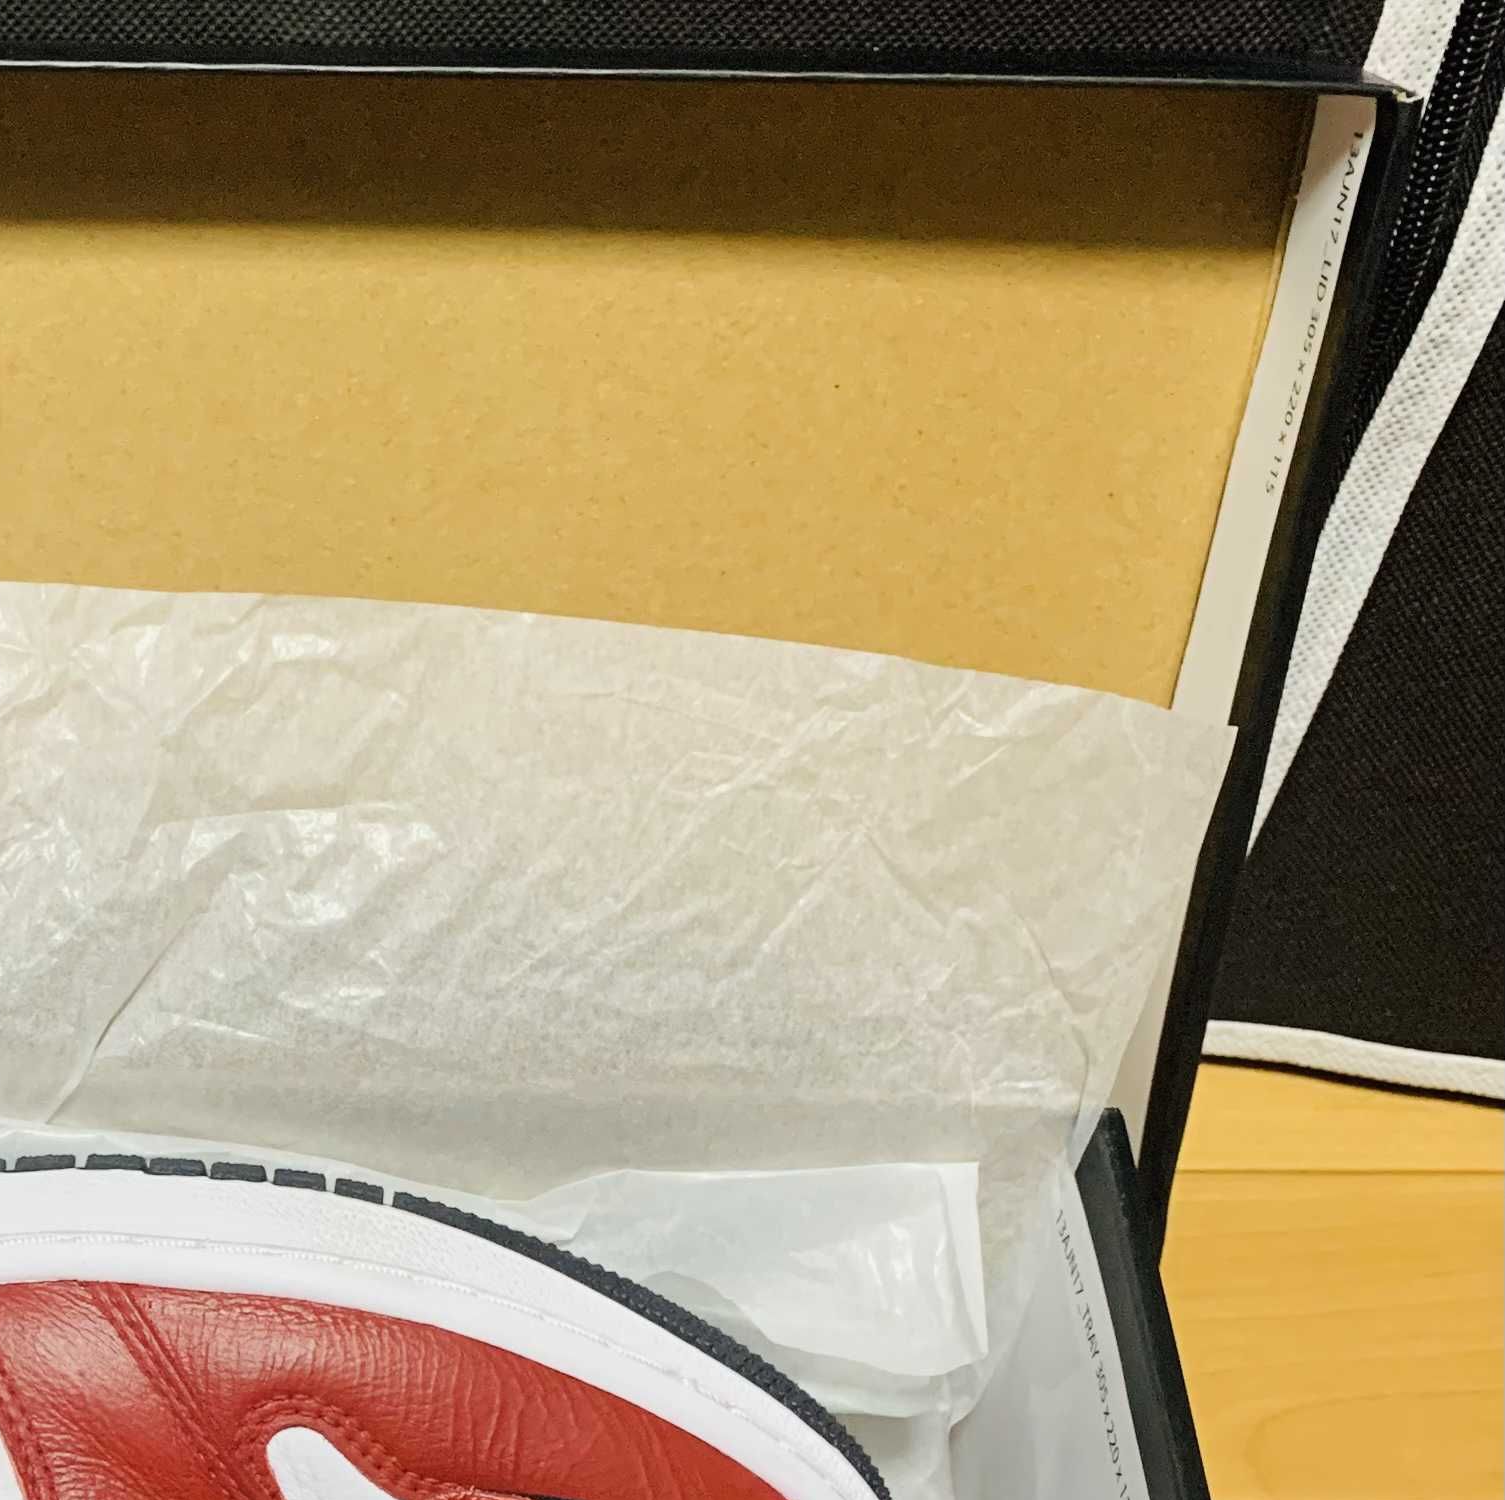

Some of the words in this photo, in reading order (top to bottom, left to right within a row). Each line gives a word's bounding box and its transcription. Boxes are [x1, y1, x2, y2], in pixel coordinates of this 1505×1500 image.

[1303, 308, 1321, 353] 305
[1284, 380, 1302, 426] 220
[1265, 455, 1283, 494] 115
[1096, 1359, 1108, 1403] 305
[1106, 1419, 1120, 1464] 220
